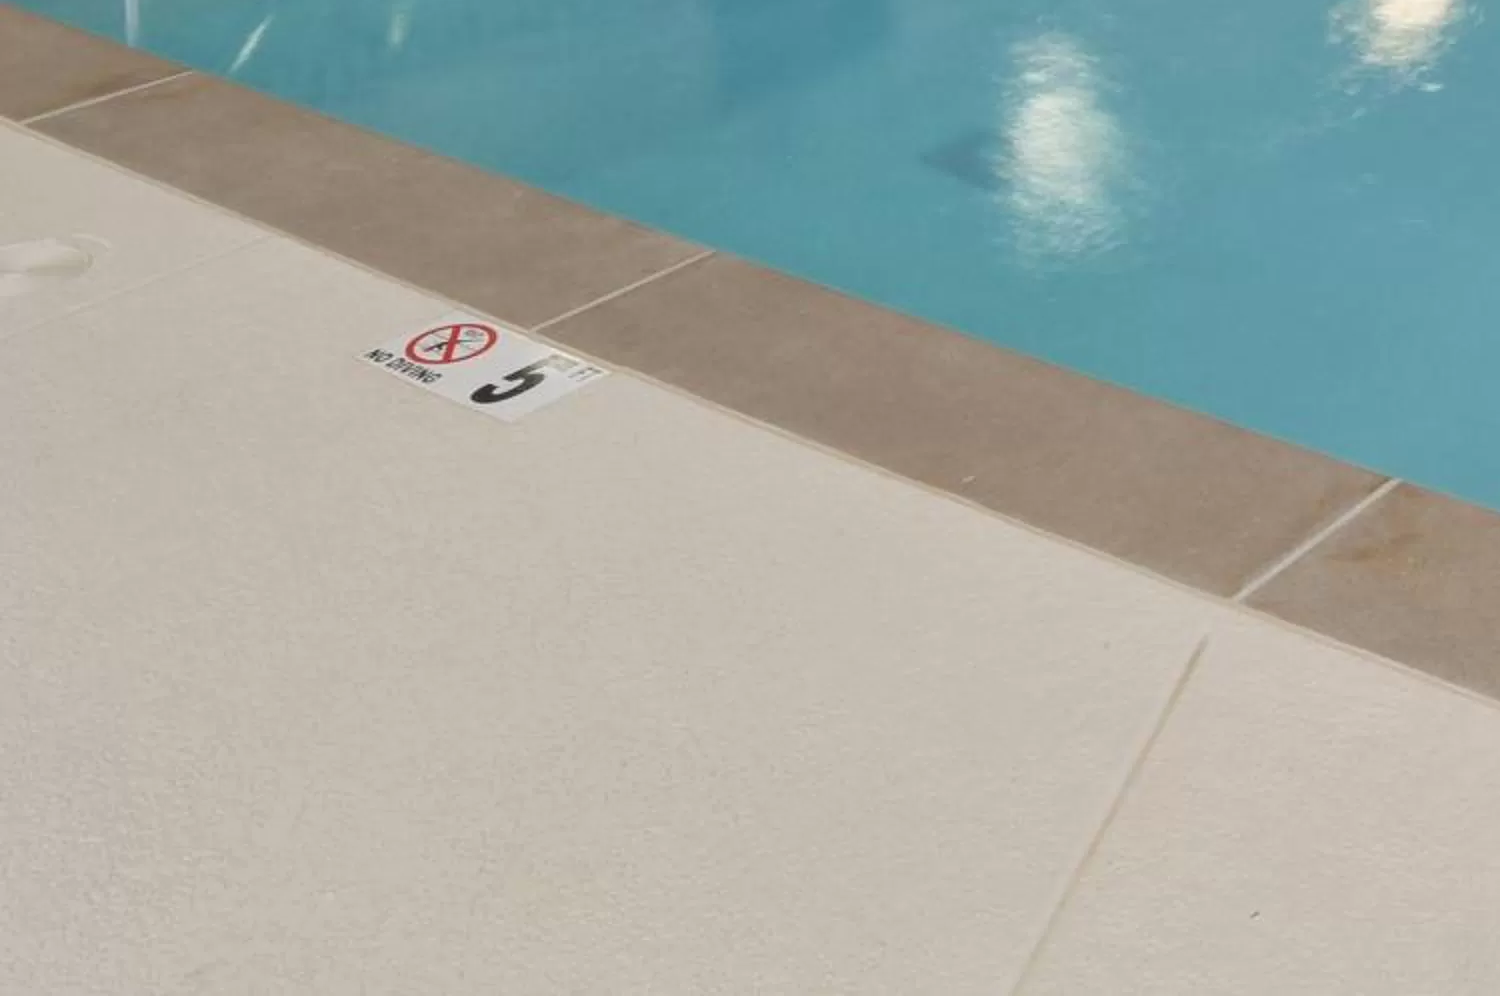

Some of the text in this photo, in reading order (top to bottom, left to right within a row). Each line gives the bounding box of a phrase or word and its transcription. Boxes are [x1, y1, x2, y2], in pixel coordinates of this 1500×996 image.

[363, 348, 443, 383] NO DIVING
[470, 353, 578, 404] 5
